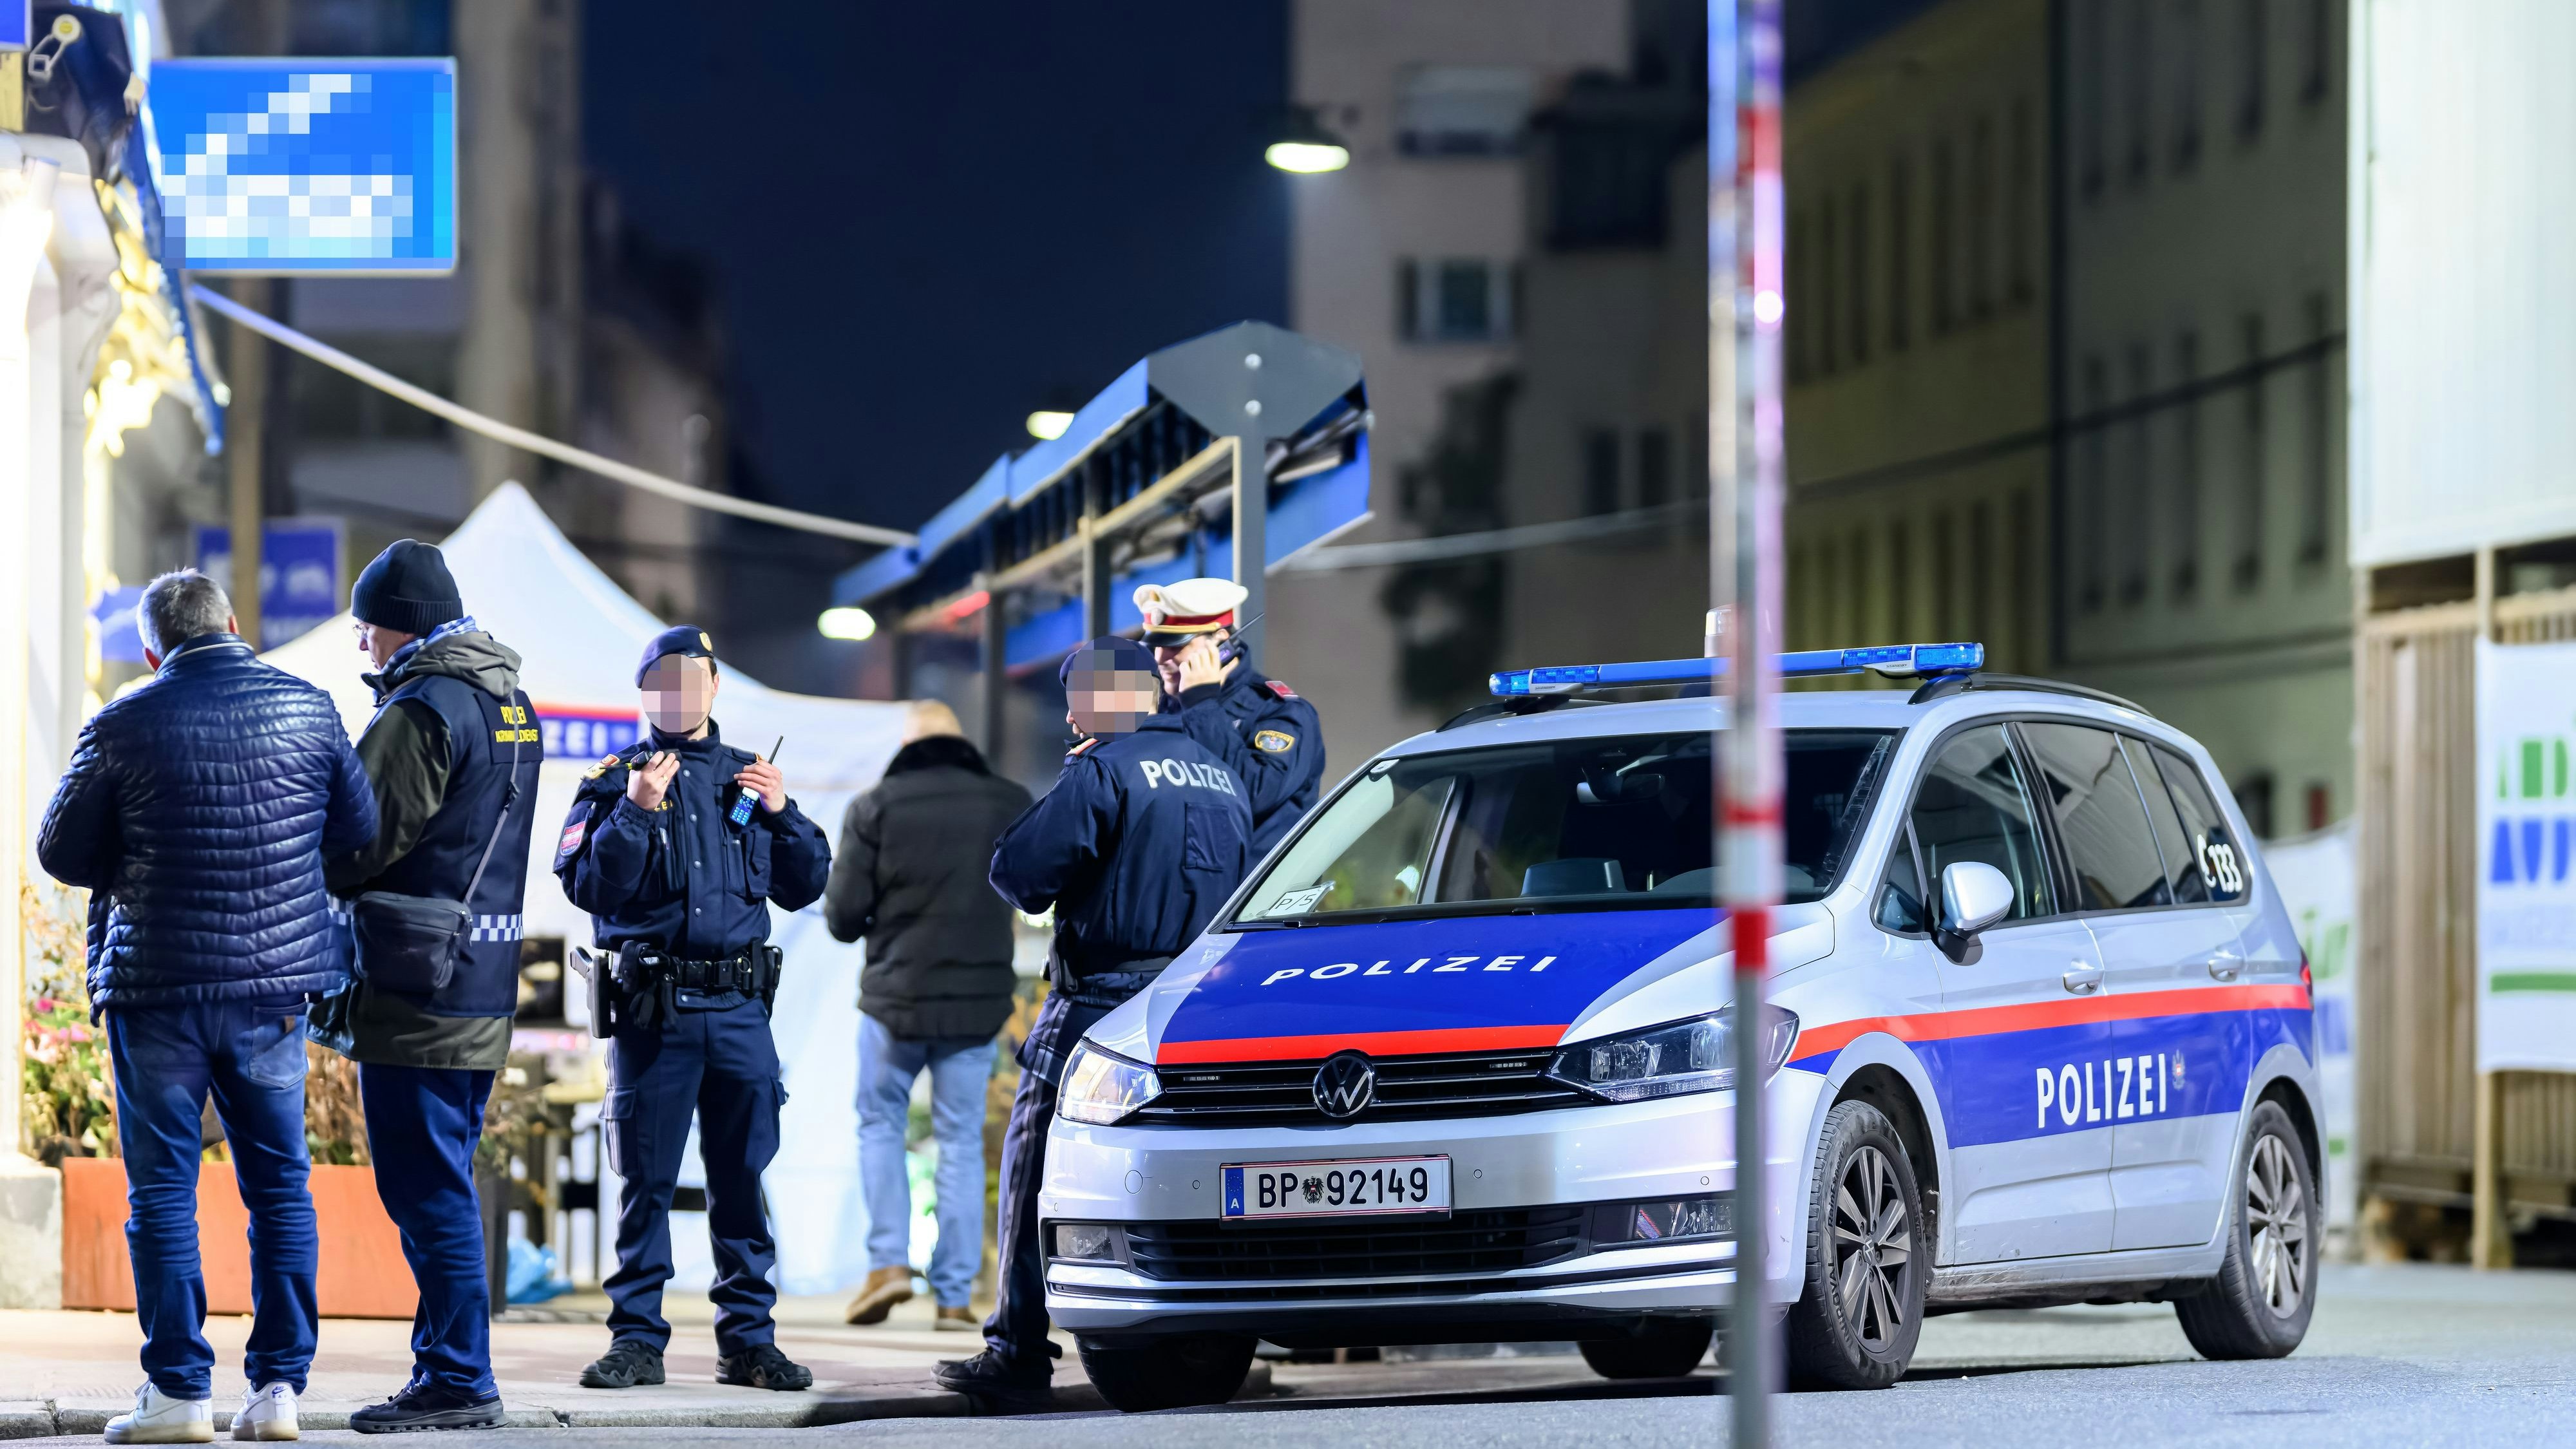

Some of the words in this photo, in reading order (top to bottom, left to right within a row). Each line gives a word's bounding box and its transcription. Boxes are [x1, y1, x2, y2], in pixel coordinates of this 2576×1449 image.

[500, 706, 527, 725] POLZEI
[1139, 758, 1237, 797] POLIZEI
[2207, 843, 2244, 893] 133
[1274, 893, 1318, 911] P/5
[1260, 956, 1557, 986] POLIZEI
[2036, 1053, 2166, 1129] POLIZEI
[1230, 1197, 1240, 1209] A
[1258, 1172, 1299, 1209] BP
[1325, 1166, 1429, 1206] 92149
